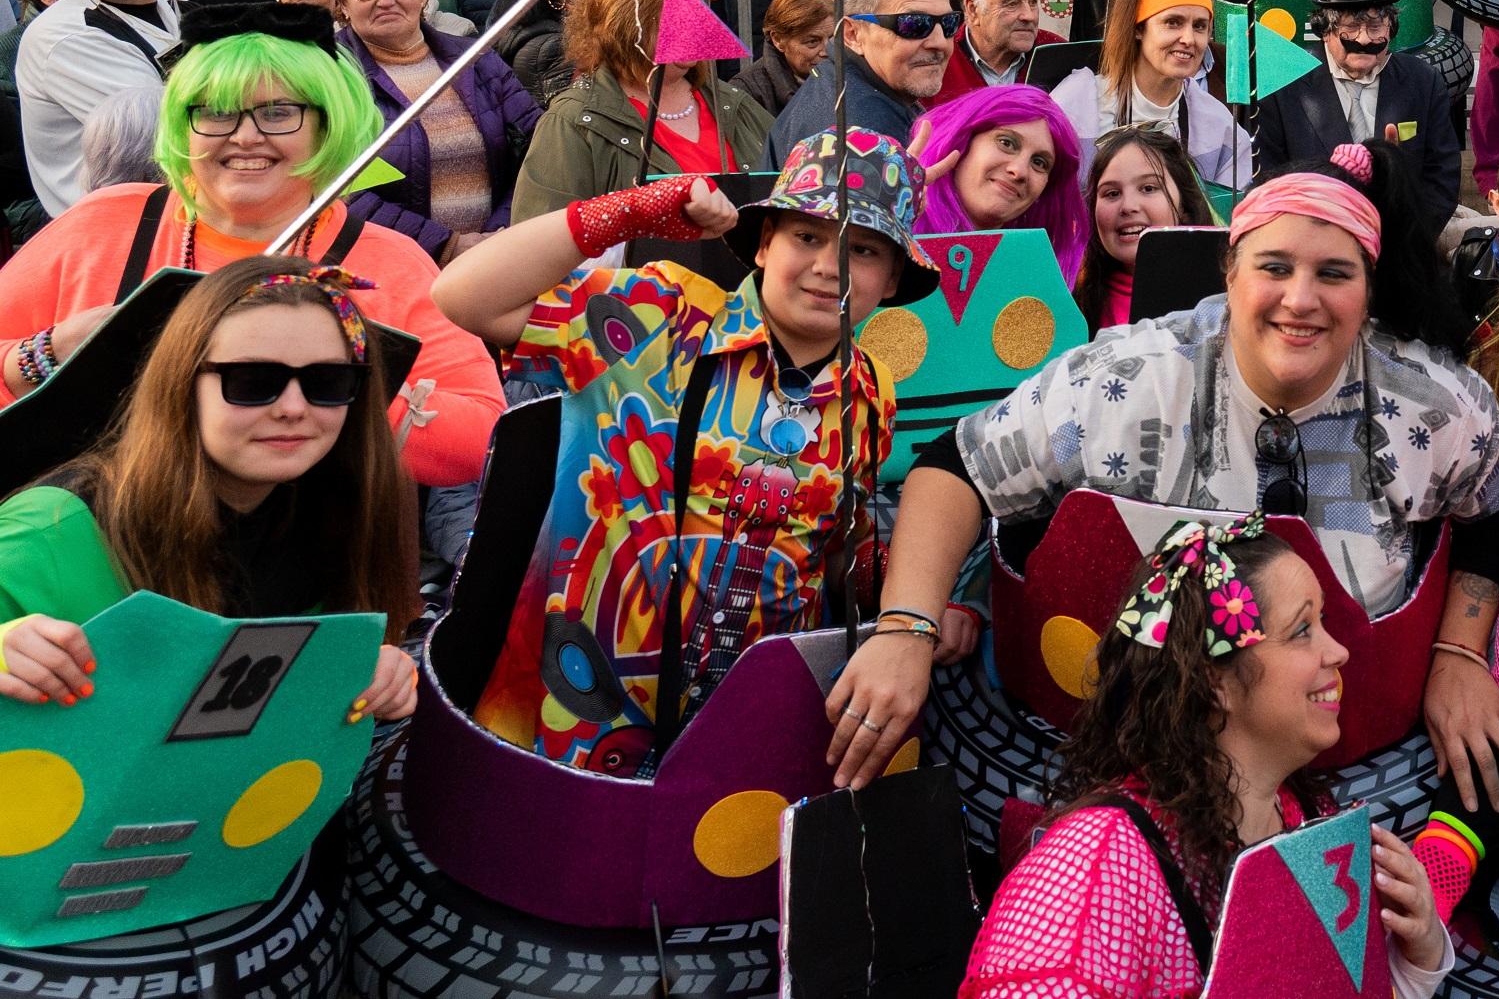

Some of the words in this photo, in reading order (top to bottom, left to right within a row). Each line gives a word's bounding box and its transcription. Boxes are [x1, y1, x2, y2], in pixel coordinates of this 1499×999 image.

[948, 245, 972, 292] 9
[202, 652, 284, 713] 18
[1323, 843, 1362, 933] 3
[235, 890, 325, 979] HIGH
